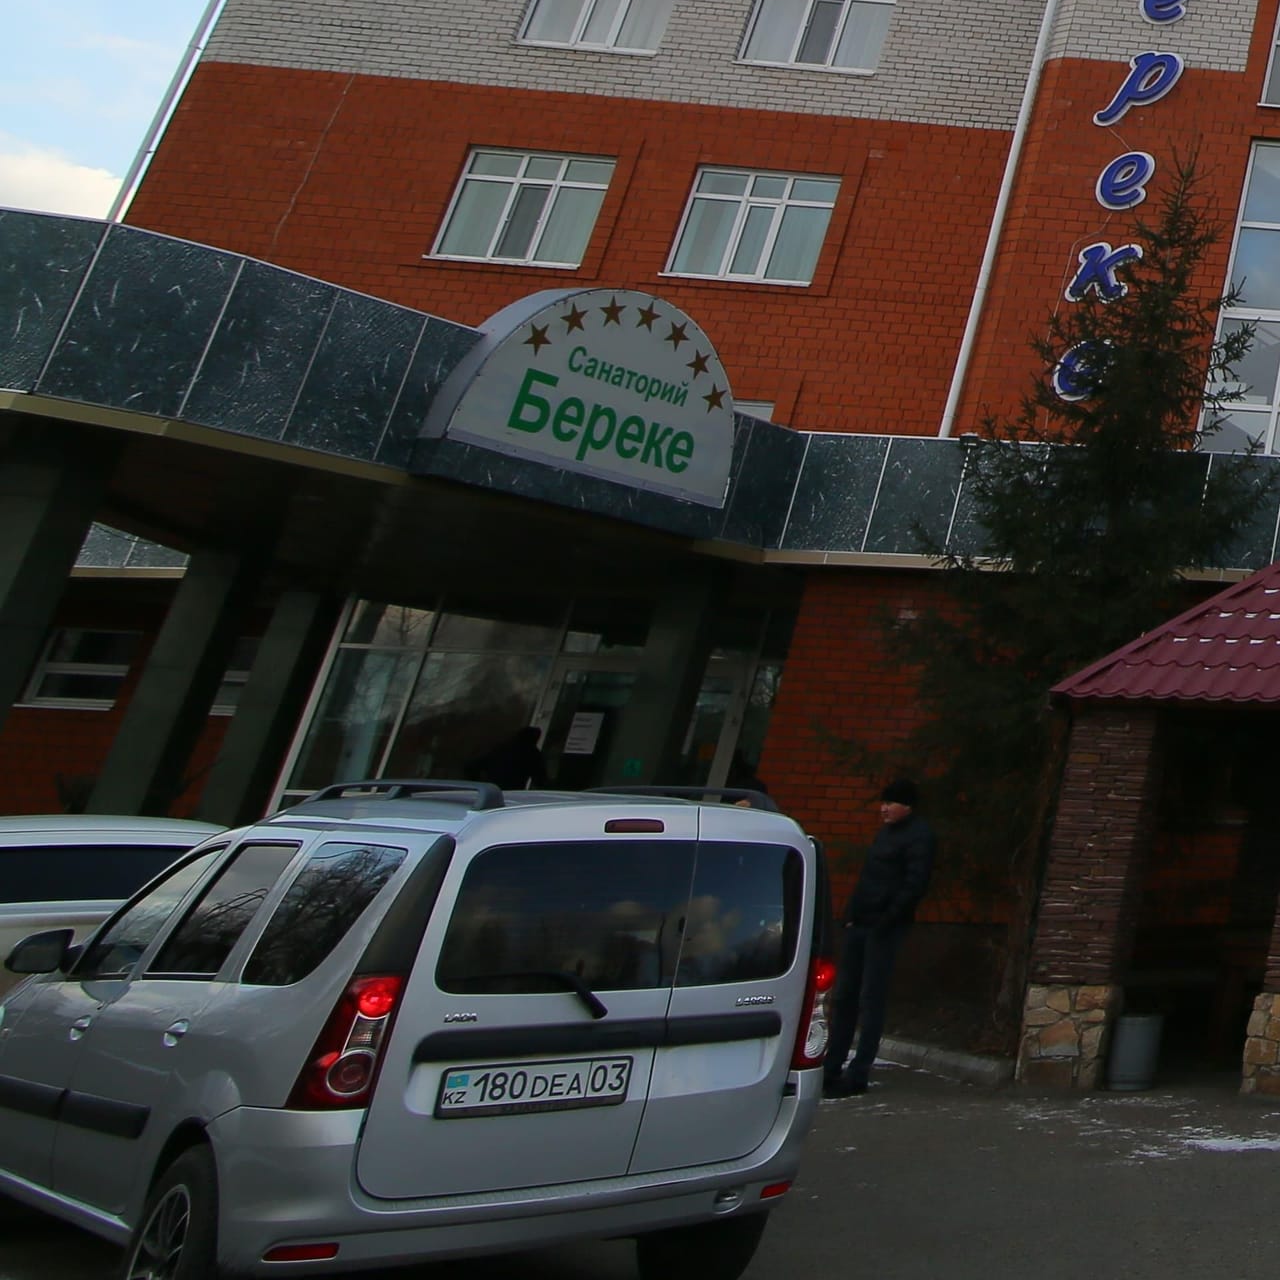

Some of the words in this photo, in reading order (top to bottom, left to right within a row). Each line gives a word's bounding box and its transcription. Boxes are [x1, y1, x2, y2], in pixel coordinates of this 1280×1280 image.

[568, 346, 689, 407] Санаторий
[507, 368, 695, 474] Береке
[442, 1091, 467, 1105] KZ
[590, 1063, 628, 1093] 03
